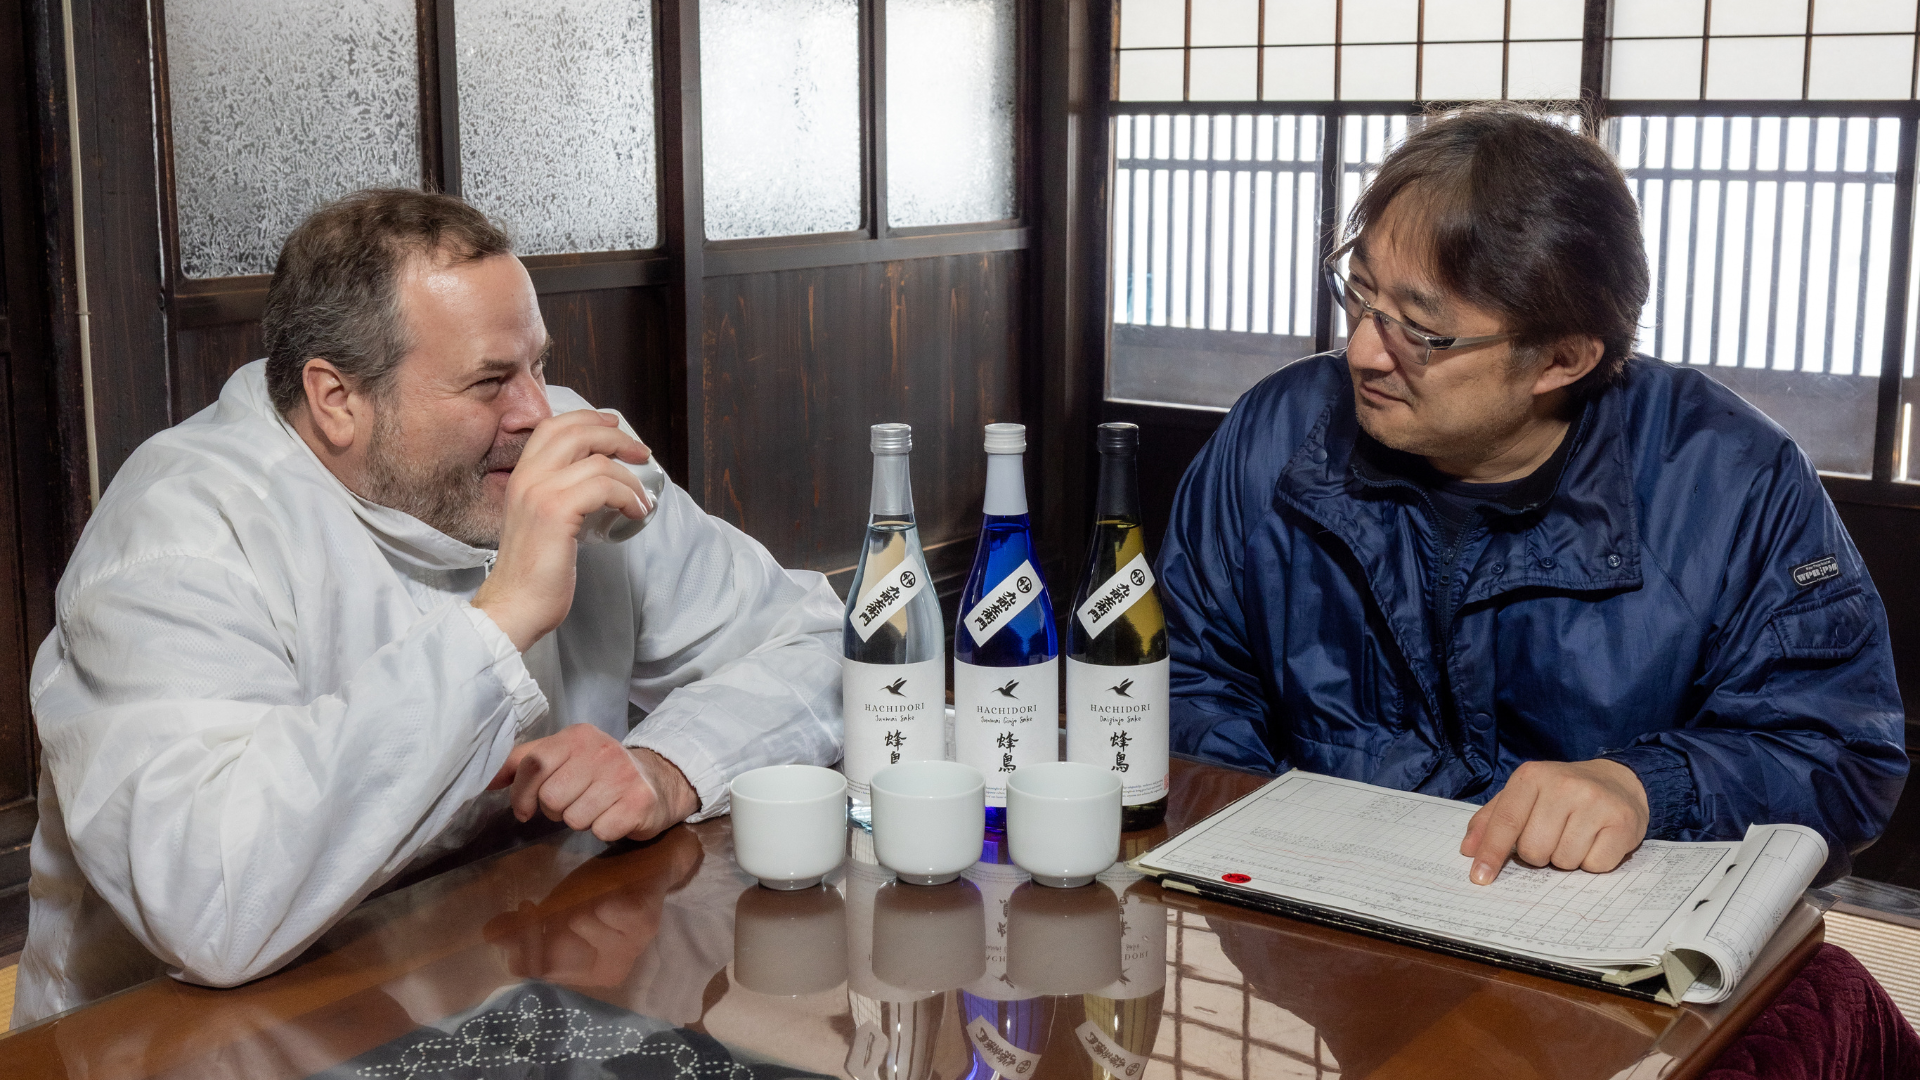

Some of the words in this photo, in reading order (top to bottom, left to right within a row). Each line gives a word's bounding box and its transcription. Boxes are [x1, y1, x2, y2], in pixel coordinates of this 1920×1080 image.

[859, 585, 900, 627] 九郎左衛門
[1087, 583, 1130, 624] 九郎左衛門
[974, 591, 1017, 632] 九郎左衛門
[864, 702, 925, 713] HACHIDORI
[976, 704, 1037, 715] HACHIDORI
[1090, 703, 1150, 714] HACHIDORI
[900, 713, 915, 722] Sake
[1019, 715, 1033, 724] Sake
[1126, 714, 1142, 724] Sake
[996, 731, 1019, 774] 蜂鳥
[1110, 730, 1133, 773] 蜂鳥
